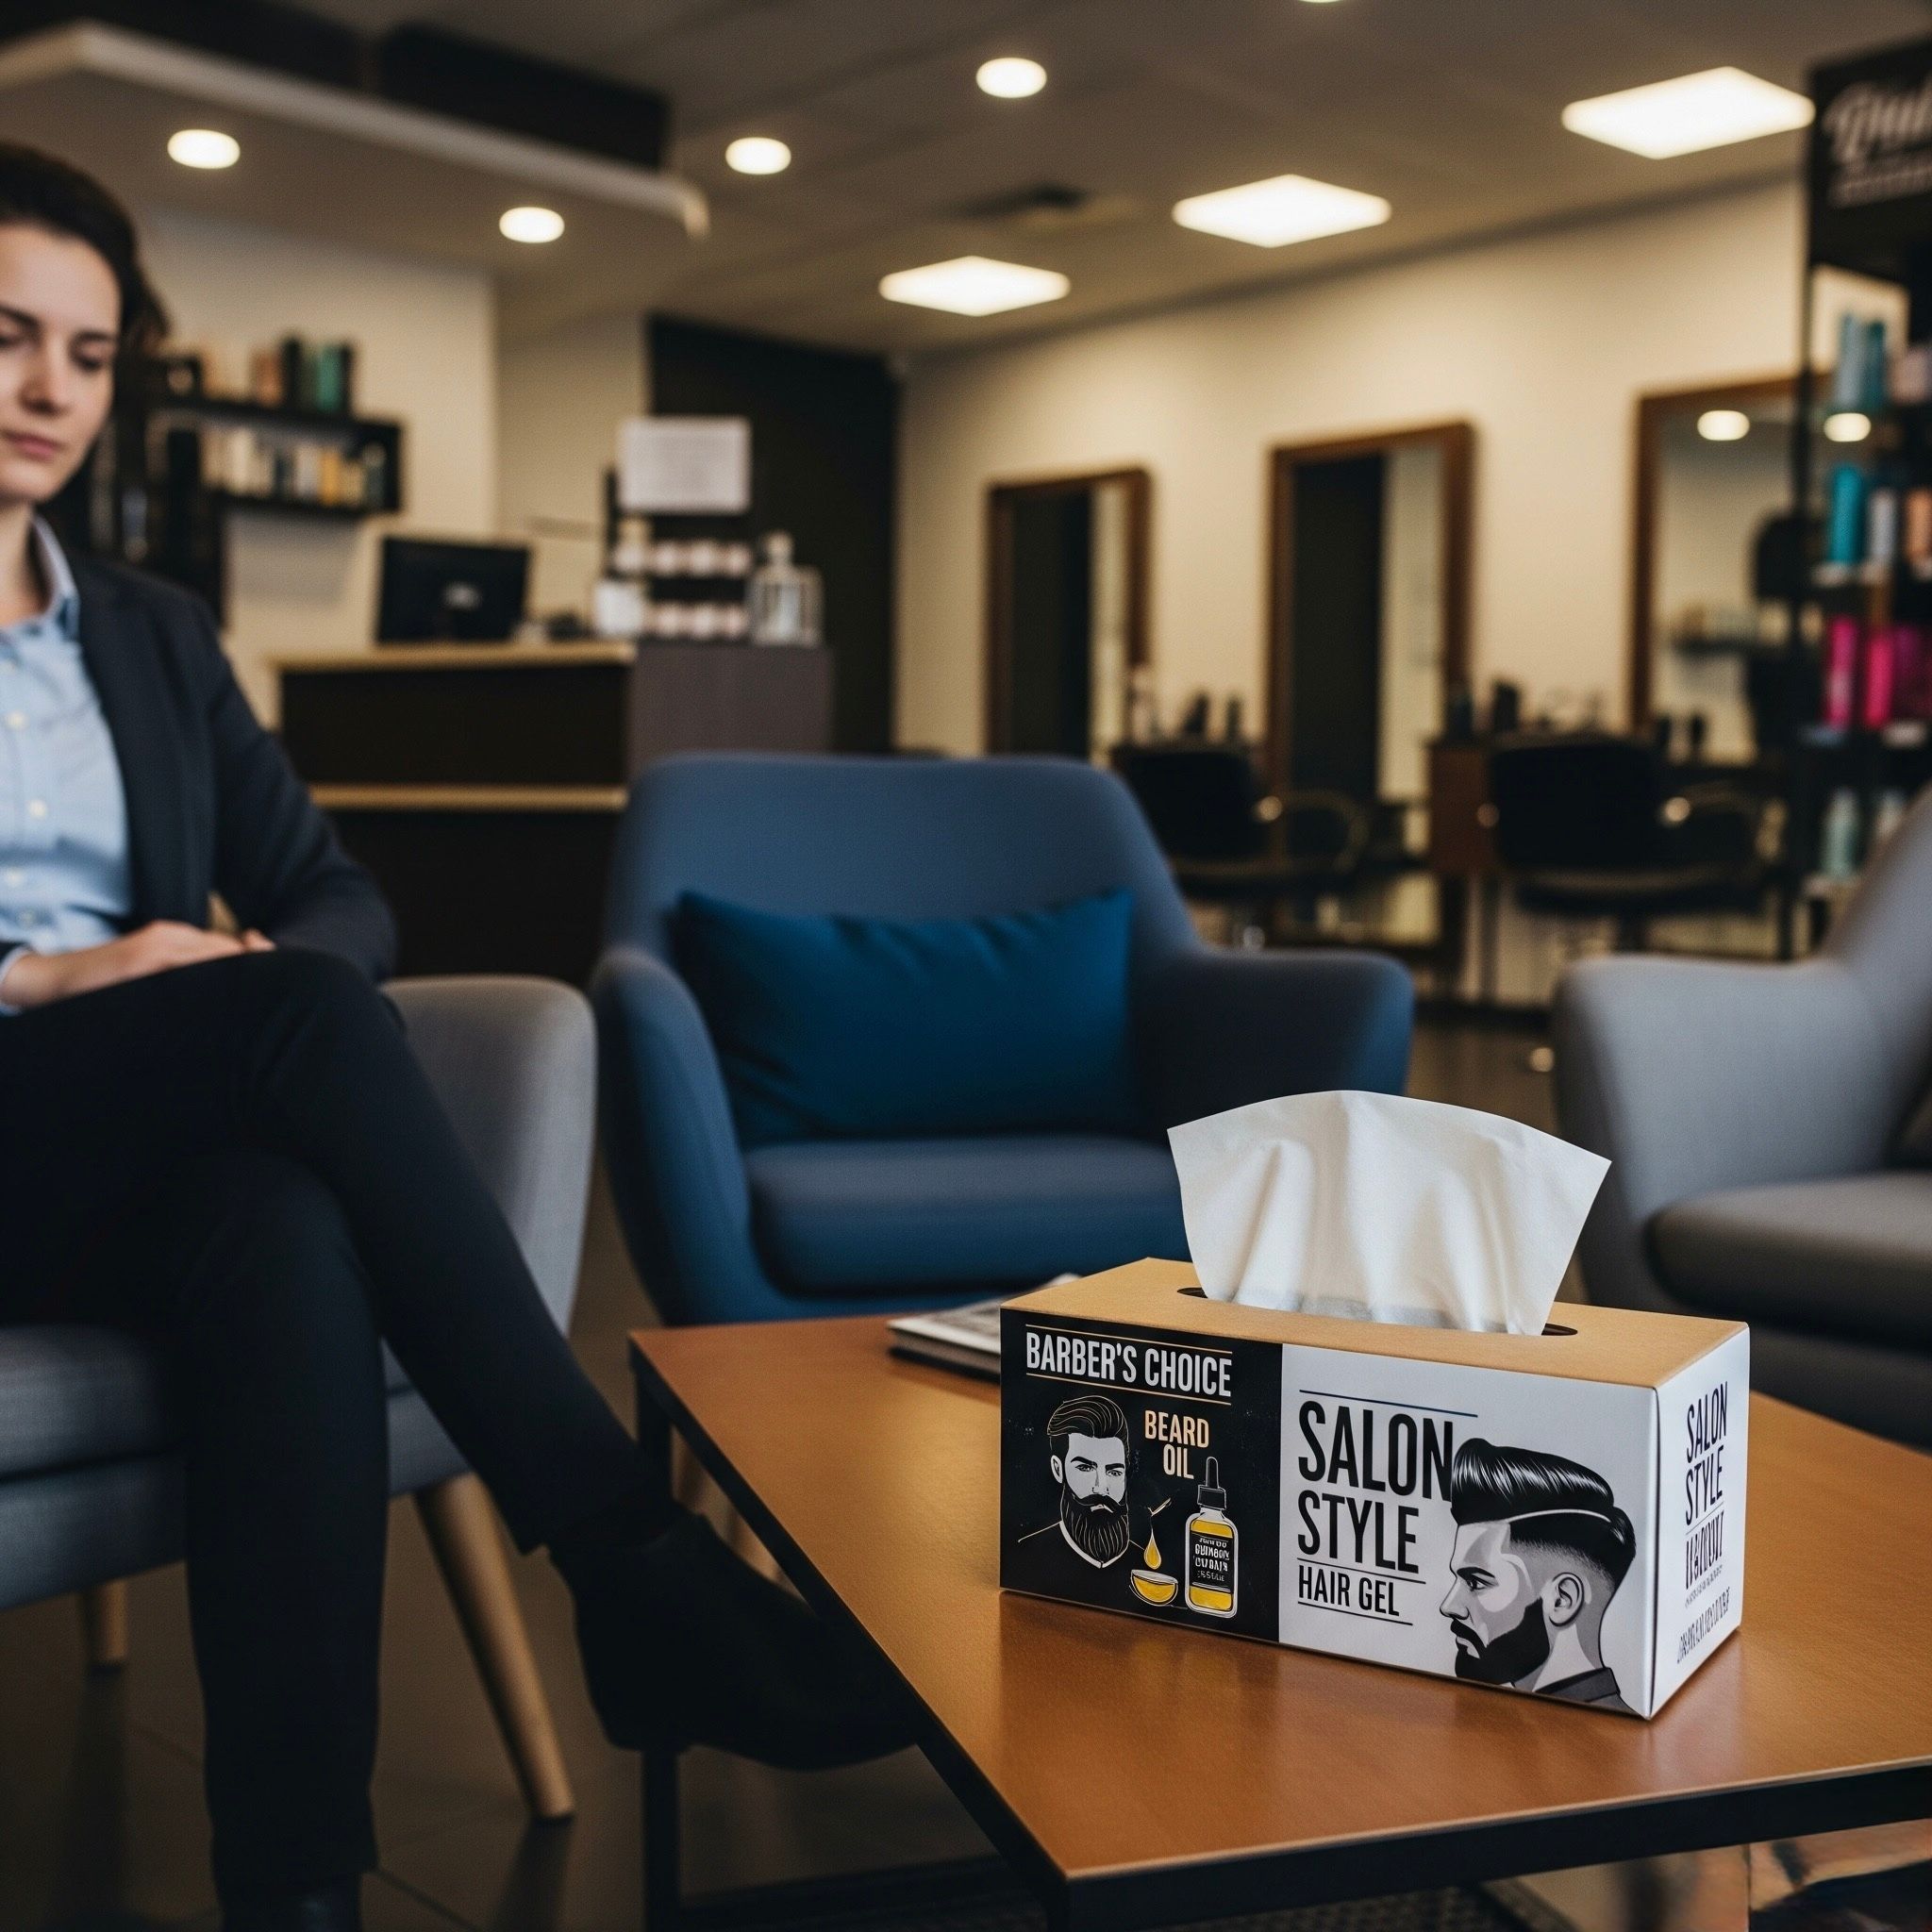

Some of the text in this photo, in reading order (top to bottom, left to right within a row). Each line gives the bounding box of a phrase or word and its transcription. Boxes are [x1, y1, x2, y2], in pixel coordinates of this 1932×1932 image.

[1026, 1332, 1232, 1397] BARBER'S CHOICE
[1144, 1410, 1209, 1448] BEARD
[1298, 1400, 1453, 1502] SALON
[1687, 1381, 1727, 1463] SALON
[1163, 1443, 1194, 1479] OIL
[1686, 1445, 1724, 1525] STYLE
[1297, 1490, 1419, 1574] STYLE
[1299, 1565, 1400, 1616] HAIR GEL
